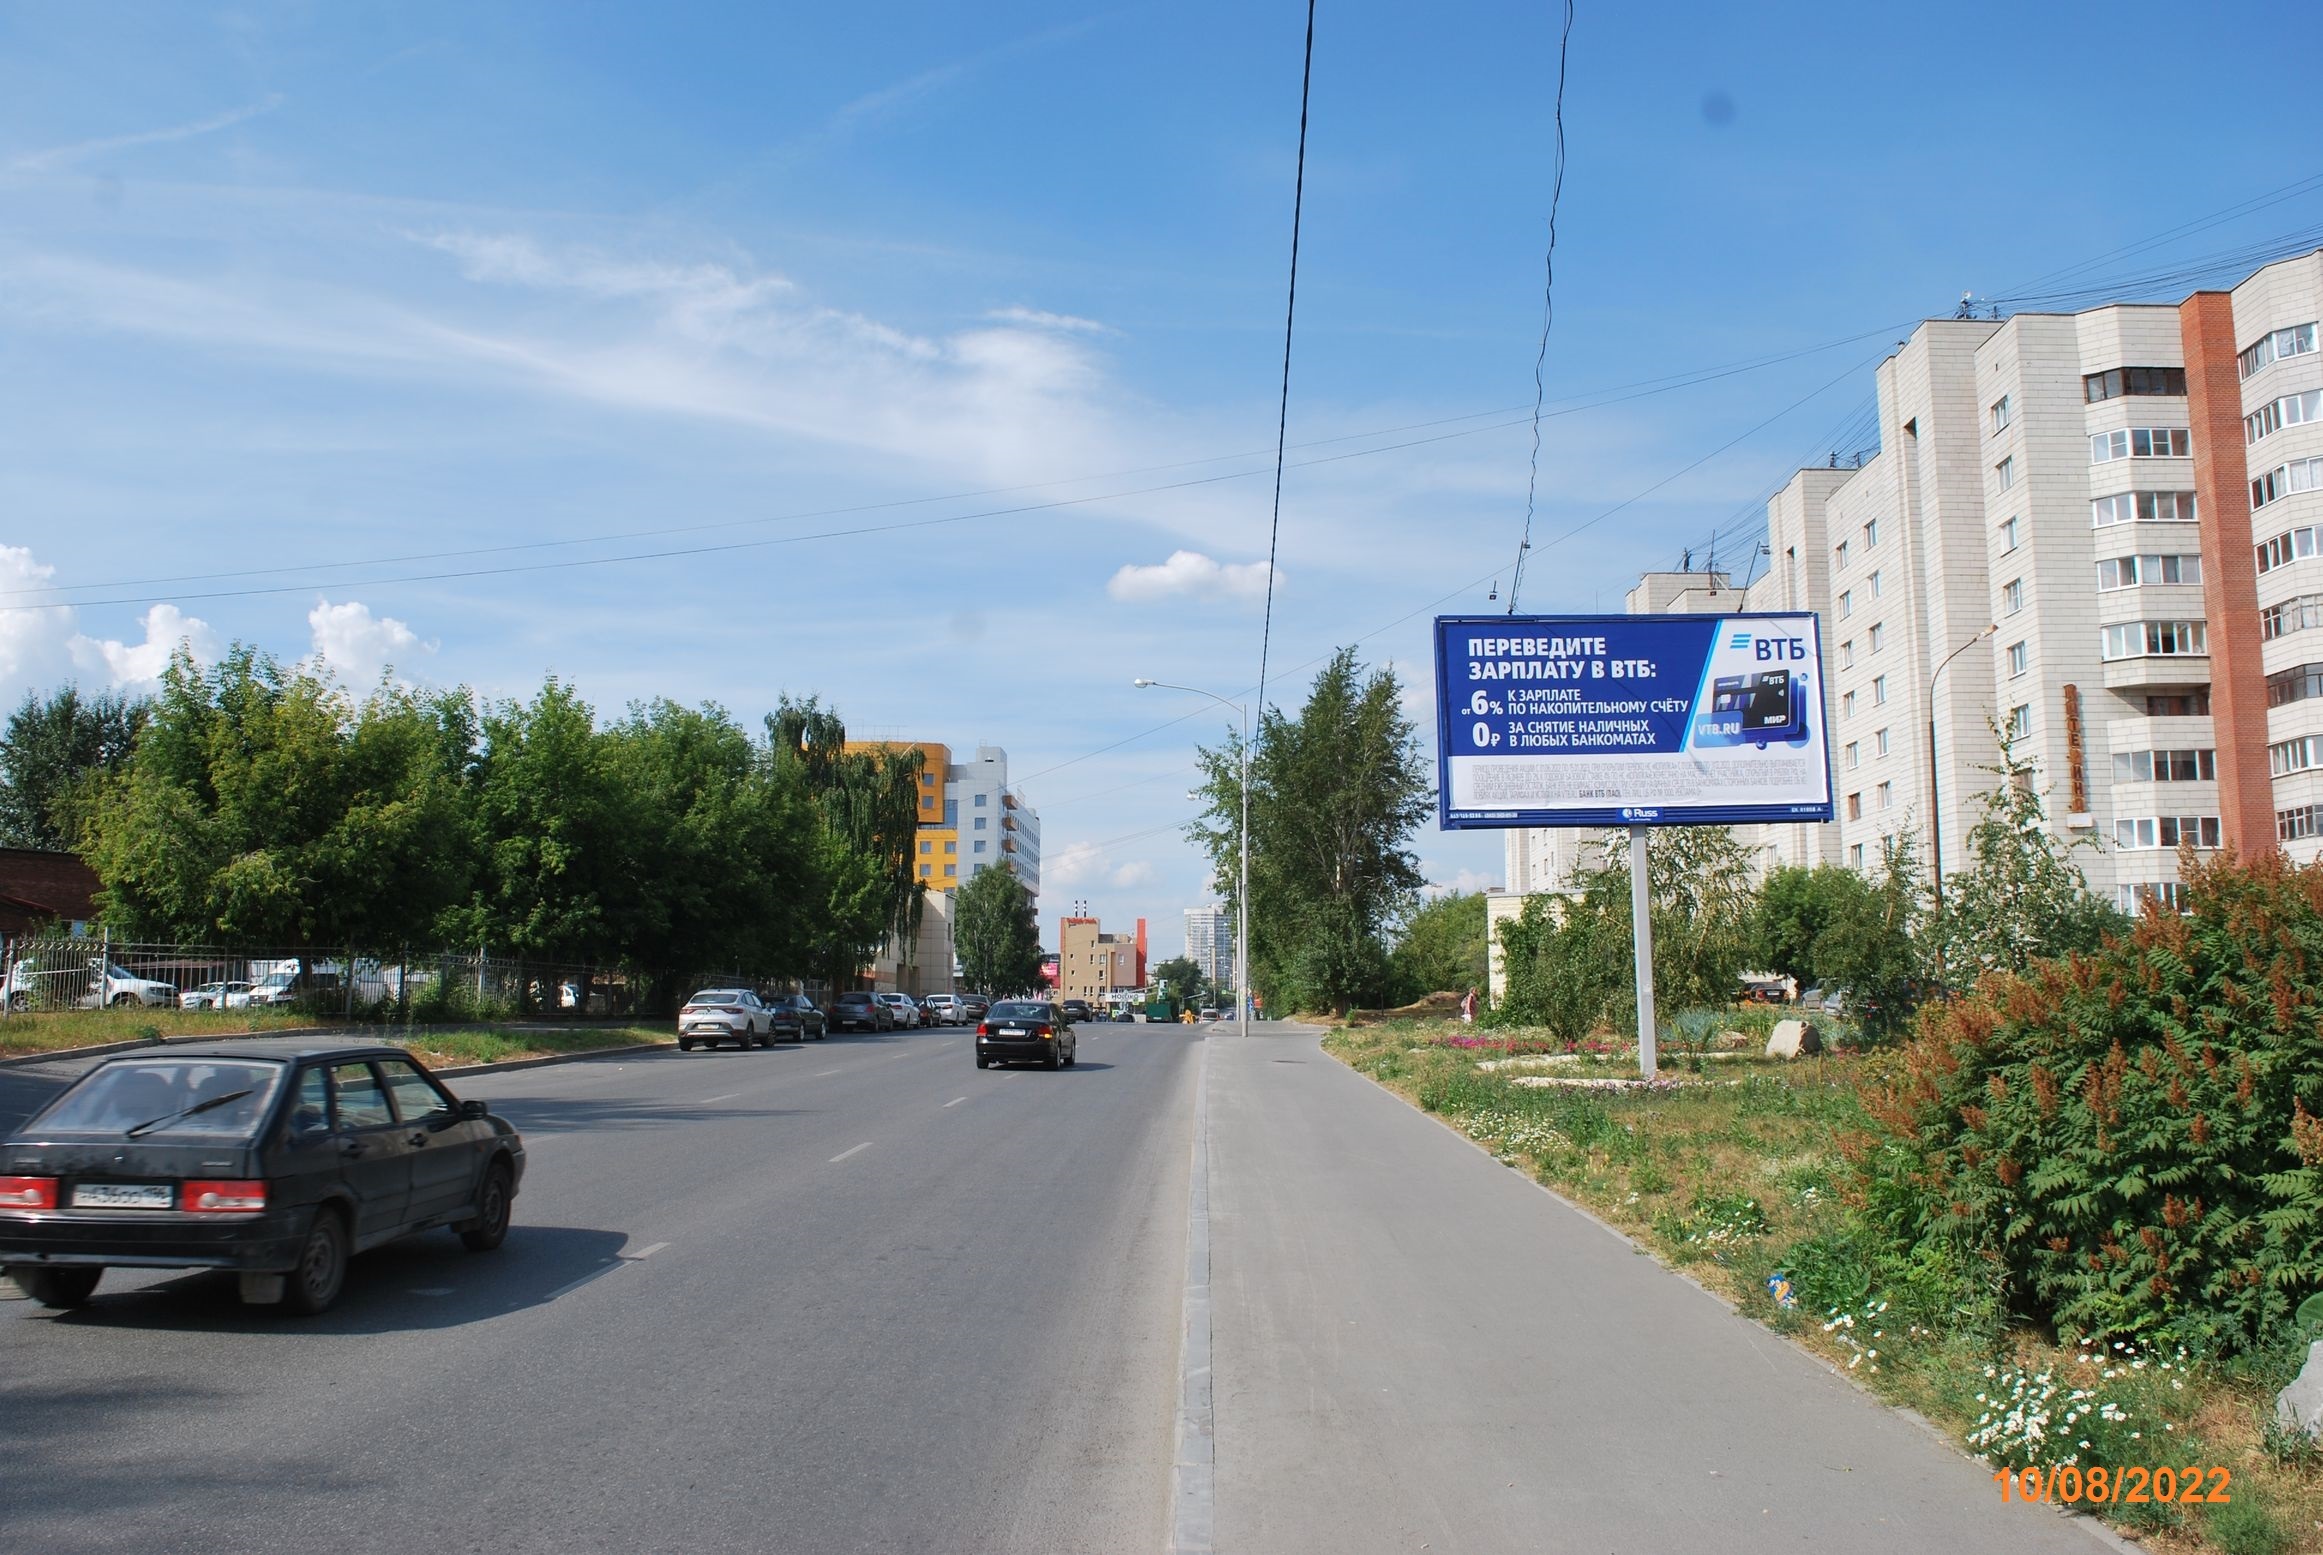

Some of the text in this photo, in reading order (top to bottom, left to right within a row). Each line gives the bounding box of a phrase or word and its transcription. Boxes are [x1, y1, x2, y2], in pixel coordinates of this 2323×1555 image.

[1468, 637, 1607, 659] ПЕРЕВЕДИТЕ
[1755, 638, 1806, 661] ВТБ
[1468, 660, 1656, 680] ЗАРПЛАТУ В ВТБ:
[1769, 675, 1785, 685] ВТБ
[1471, 690, 1503, 715] 6%
[1508, 689, 1581, 702] К ЗАРПЛАТЕ
[1508, 697, 1689, 715] ПО НАКОПИТЕЛЬНОМУ СЧЁТУ
[1508, 719, 1650, 734] ЗА СНЯТИЕ НАЛИЧНЫХ
[1763, 715, 1787, 725] МИР
[1697, 722, 1740, 735] VTB.RU
[1509, 733, 1656, 747] В ЛЮБЫХ БАНКОМАТАХ
[1633, 808, 1658, 818] Russ
